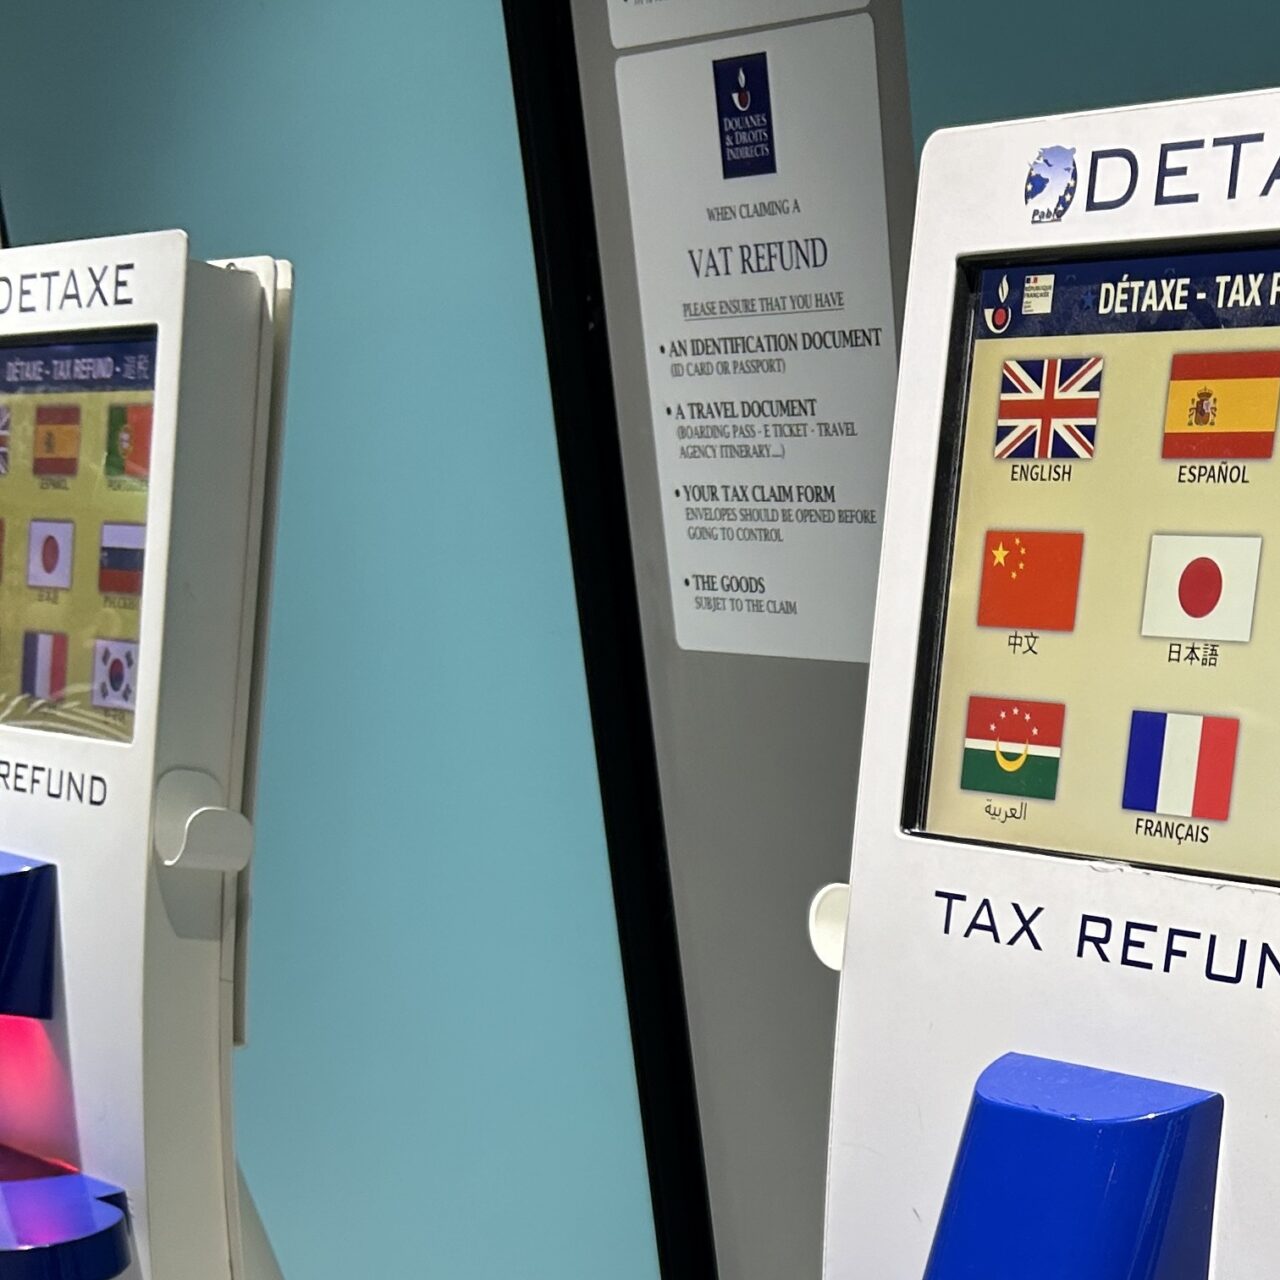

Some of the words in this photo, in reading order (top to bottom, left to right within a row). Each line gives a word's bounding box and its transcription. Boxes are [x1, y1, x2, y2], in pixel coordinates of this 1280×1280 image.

[723, 113, 767, 131] DOUANES
[725, 134, 734, 147] &
[734, 128, 769, 145] DROITS
[726, 143, 770, 161] INDIRECTS
[707, 206, 737, 222] WHEN
[739, 200, 790, 220] CLAIMING
[791, 199, 801, 213] A
[688, 246, 733, 279] VAT
[739, 237, 828, 276] REFUND
[0, 263, 134, 315] DETAXE
[1098, 275, 1190, 315] DÉTAXE
[1215, 274, 1267, 309] TAX
[682, 302, 717, 318] PLEASE
[719, 298, 756, 315] ENSURE
[758, 295, 788, 312] THAT
[789, 293, 814, 311] YOU
[815, 291, 844, 308] HAVE
[669, 340, 687, 358] AN
[690, 333, 798, 356] IDENTIFICATION
[802, 328, 882, 350] DOCUMENT
[671, 361, 684, 377] (ID
[686, 360, 714, 376] CARD
[716, 360, 730, 375] OR
[733, 358, 786, 374] PASSPORT)
[675, 404, 685, 420] A
[688, 401, 738, 419] TRAVEL
[741, 399, 817, 418] DOCUMENT
[677, 424, 730, 440] (BOARDING
[733, 424, 756, 438] PASS
[764, 424, 770, 437] E
[772, 423, 809, 437] TICKET
[817, 422, 858, 437] TRAVEL
[679, 445, 718, 459] AGENCY
[1011, 464, 1072, 482] ENGLISH
[1177, 461, 1250, 484] ESPAÑOL
[683, 485, 719, 502] YOUR
[722, 485, 750, 502] TAX
[752, 485, 793, 502] CLAIM
[797, 486, 836, 503] FORM
[686, 507, 737, 522] ENVELOPES
[739, 508, 779, 522] SHOULD
[781, 509, 794, 522] BE
[796, 509, 835, 523] OPENED
[838, 510, 877, 524] BEFORE
[688, 527, 718, 541] GOING
[720, 527, 734, 541] TO
[736, 527, 783, 542] CONTROL
[692, 575, 718, 592] THE
[721, 575, 765, 594] GOODS
[695, 597, 727, 612] SUBJET
[730, 598, 743, 612] TO
[746, 598, 765, 613] THE
[766, 600, 798, 615] CLAIM
[1007, 631, 1040, 656] 中文
[1168, 643, 1219, 667] 日本語
[0, 761, 107, 806] REFUND
[984, 799, 1028, 823] العربية
[1135, 818, 1210, 845] FRANÇAIS
[934, 891, 1045, 951] TAX
